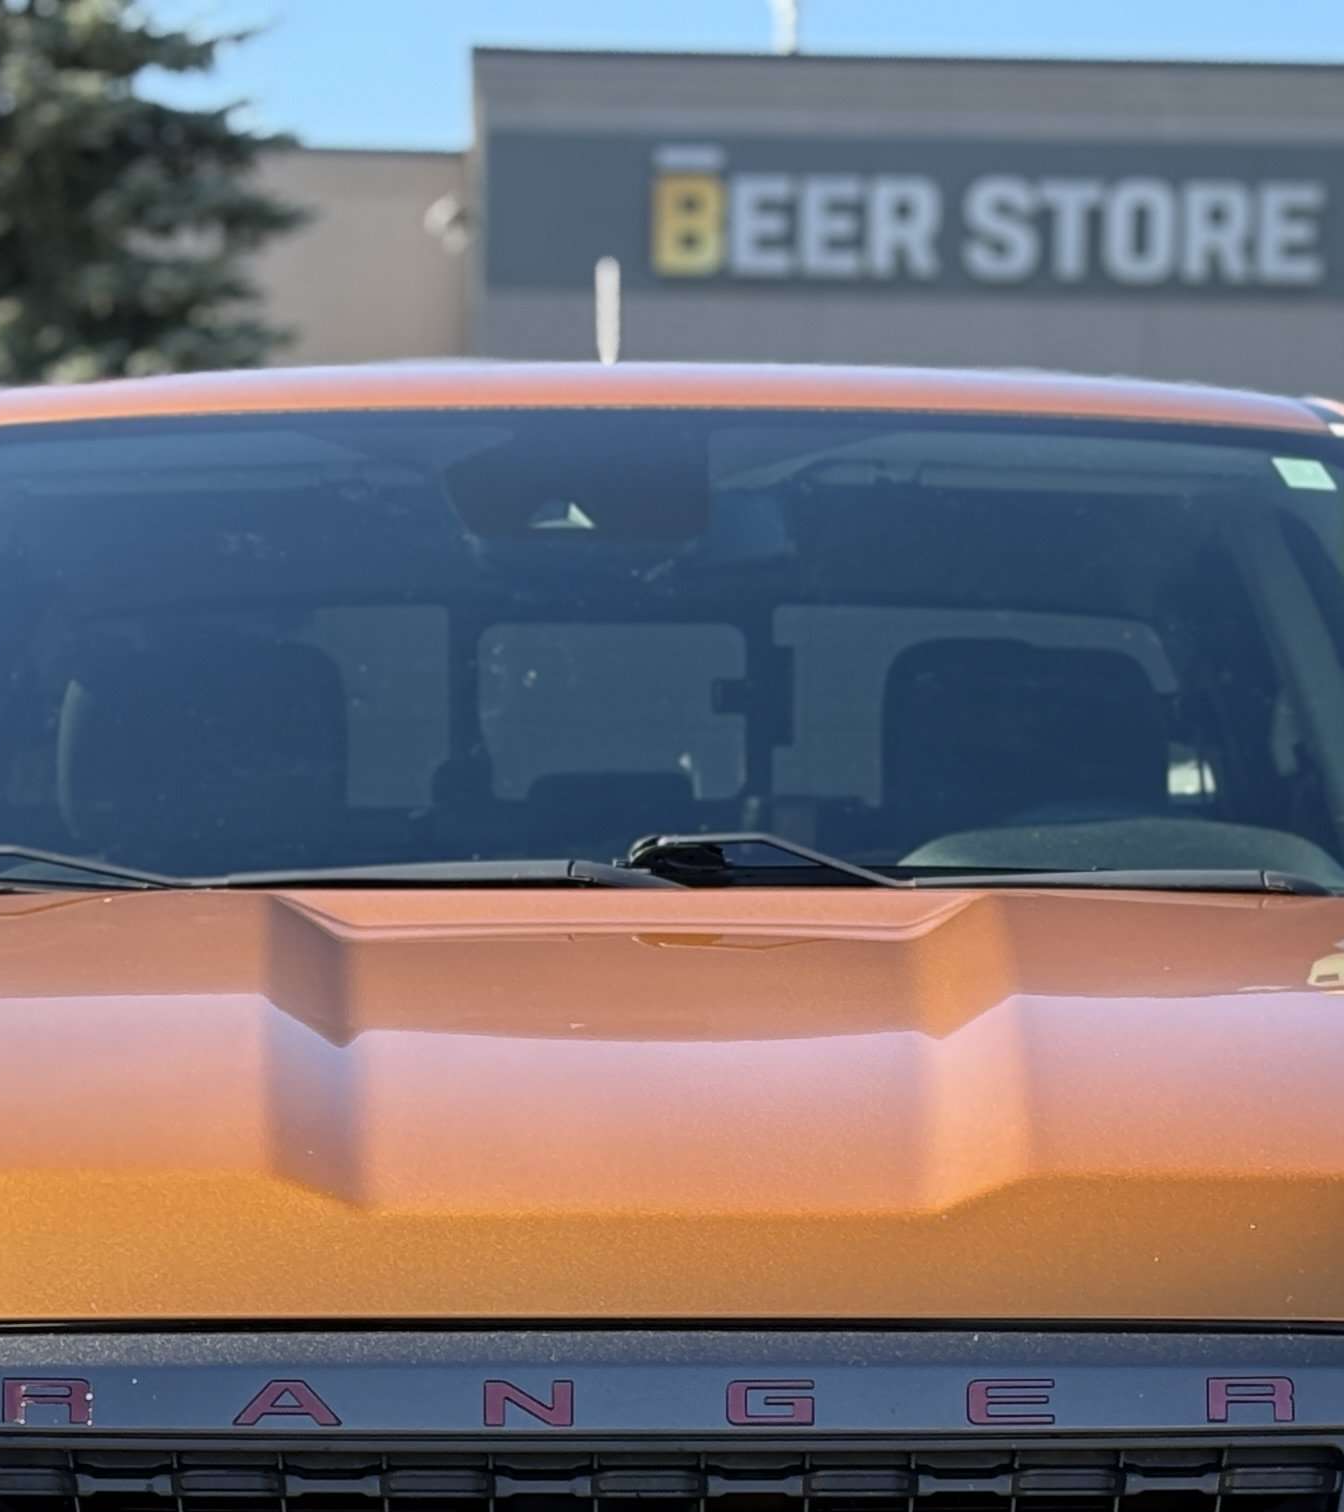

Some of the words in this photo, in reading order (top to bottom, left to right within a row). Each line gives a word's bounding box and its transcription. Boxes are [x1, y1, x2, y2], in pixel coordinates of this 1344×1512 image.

[652, 172, 940, 277] BEER
[962, 176, 1324, 282] STORE
[2, 1377, 1295, 1427] RANGER
